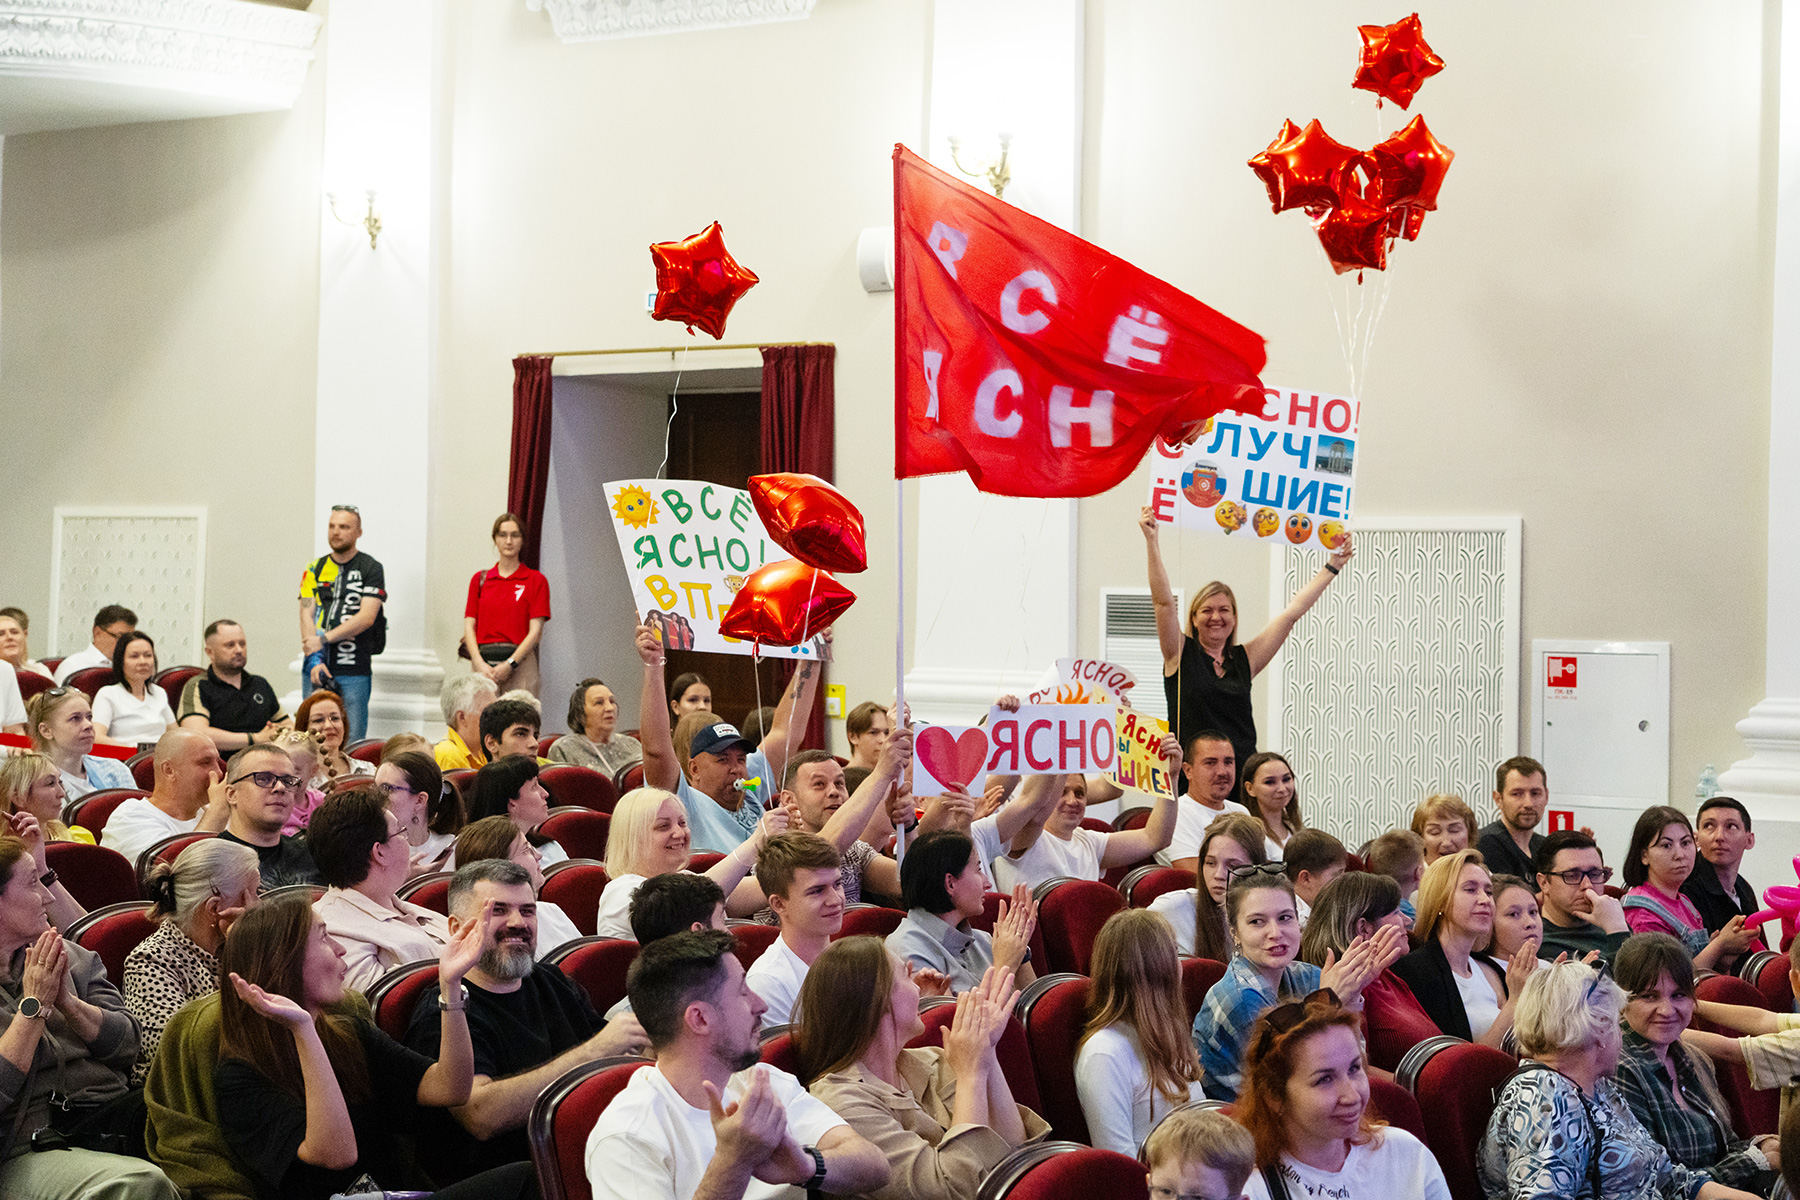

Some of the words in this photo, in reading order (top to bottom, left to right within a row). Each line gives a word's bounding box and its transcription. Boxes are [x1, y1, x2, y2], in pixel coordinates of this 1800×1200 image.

[1219, 388, 1361, 434] СНО!
[1207, 421, 1312, 470] ЛУЧ
[661, 485, 752, 533] ВСЁ
[1241, 468, 1351, 520] ШИЕ!
[633, 532, 765, 572] ЯСНО!
[1071, 659, 1136, 696] ЯСНО!
[987, 718, 1115, 772] ЯСНО
